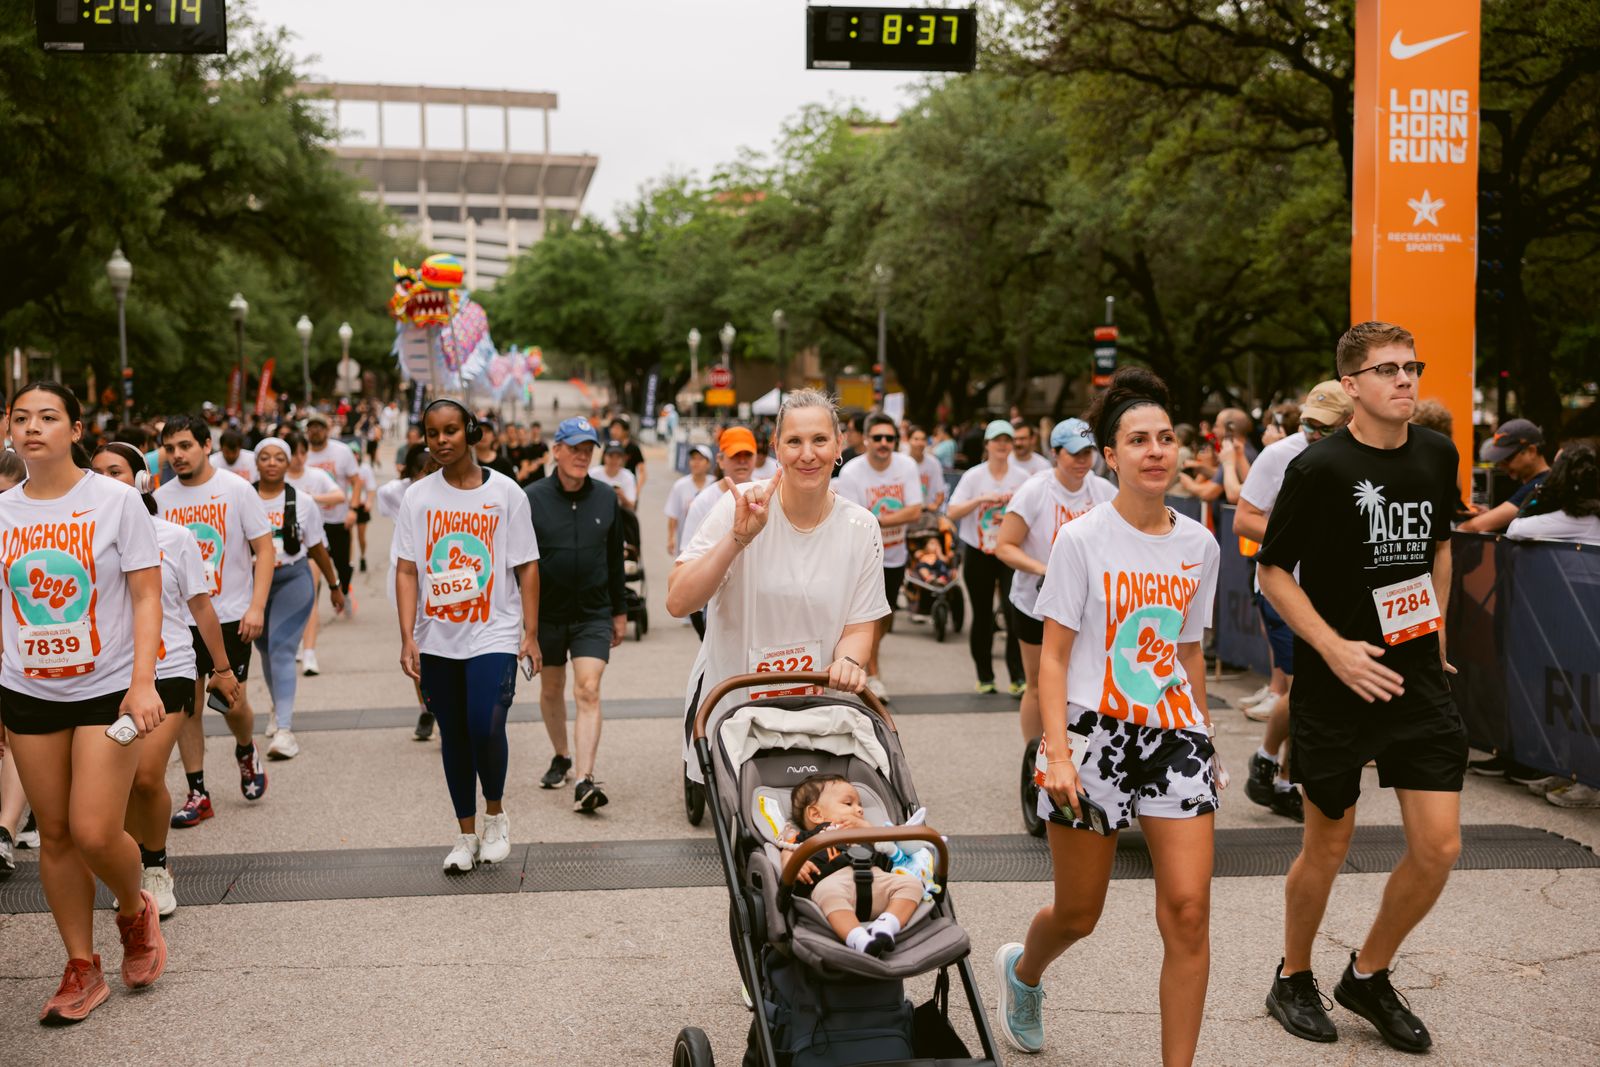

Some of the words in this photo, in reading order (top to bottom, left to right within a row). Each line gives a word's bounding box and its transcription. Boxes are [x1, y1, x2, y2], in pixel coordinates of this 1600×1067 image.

[1390, 88, 1469, 113] LONG
[1389, 113, 1469, 138] HORN
[1388, 138, 1448, 163] RUN
[1387, 232, 1463, 243] RECREATIONAL
[1405, 242, 1445, 252] SPORTS
[1372, 501, 1433, 542] ACES
[425, 509, 500, 562] LONGHORN
[1406, 541, 1428, 552] CREW
[2, 521, 96, 588] LONGHORN
[30, 567, 77, 609] 2026
[431, 578, 473, 596] 8052
[1382, 589, 1430, 619] 7284
[24, 636, 80, 656] 7839
[1136, 626, 1176, 678] 202
[786, 765, 818, 773] nuna
